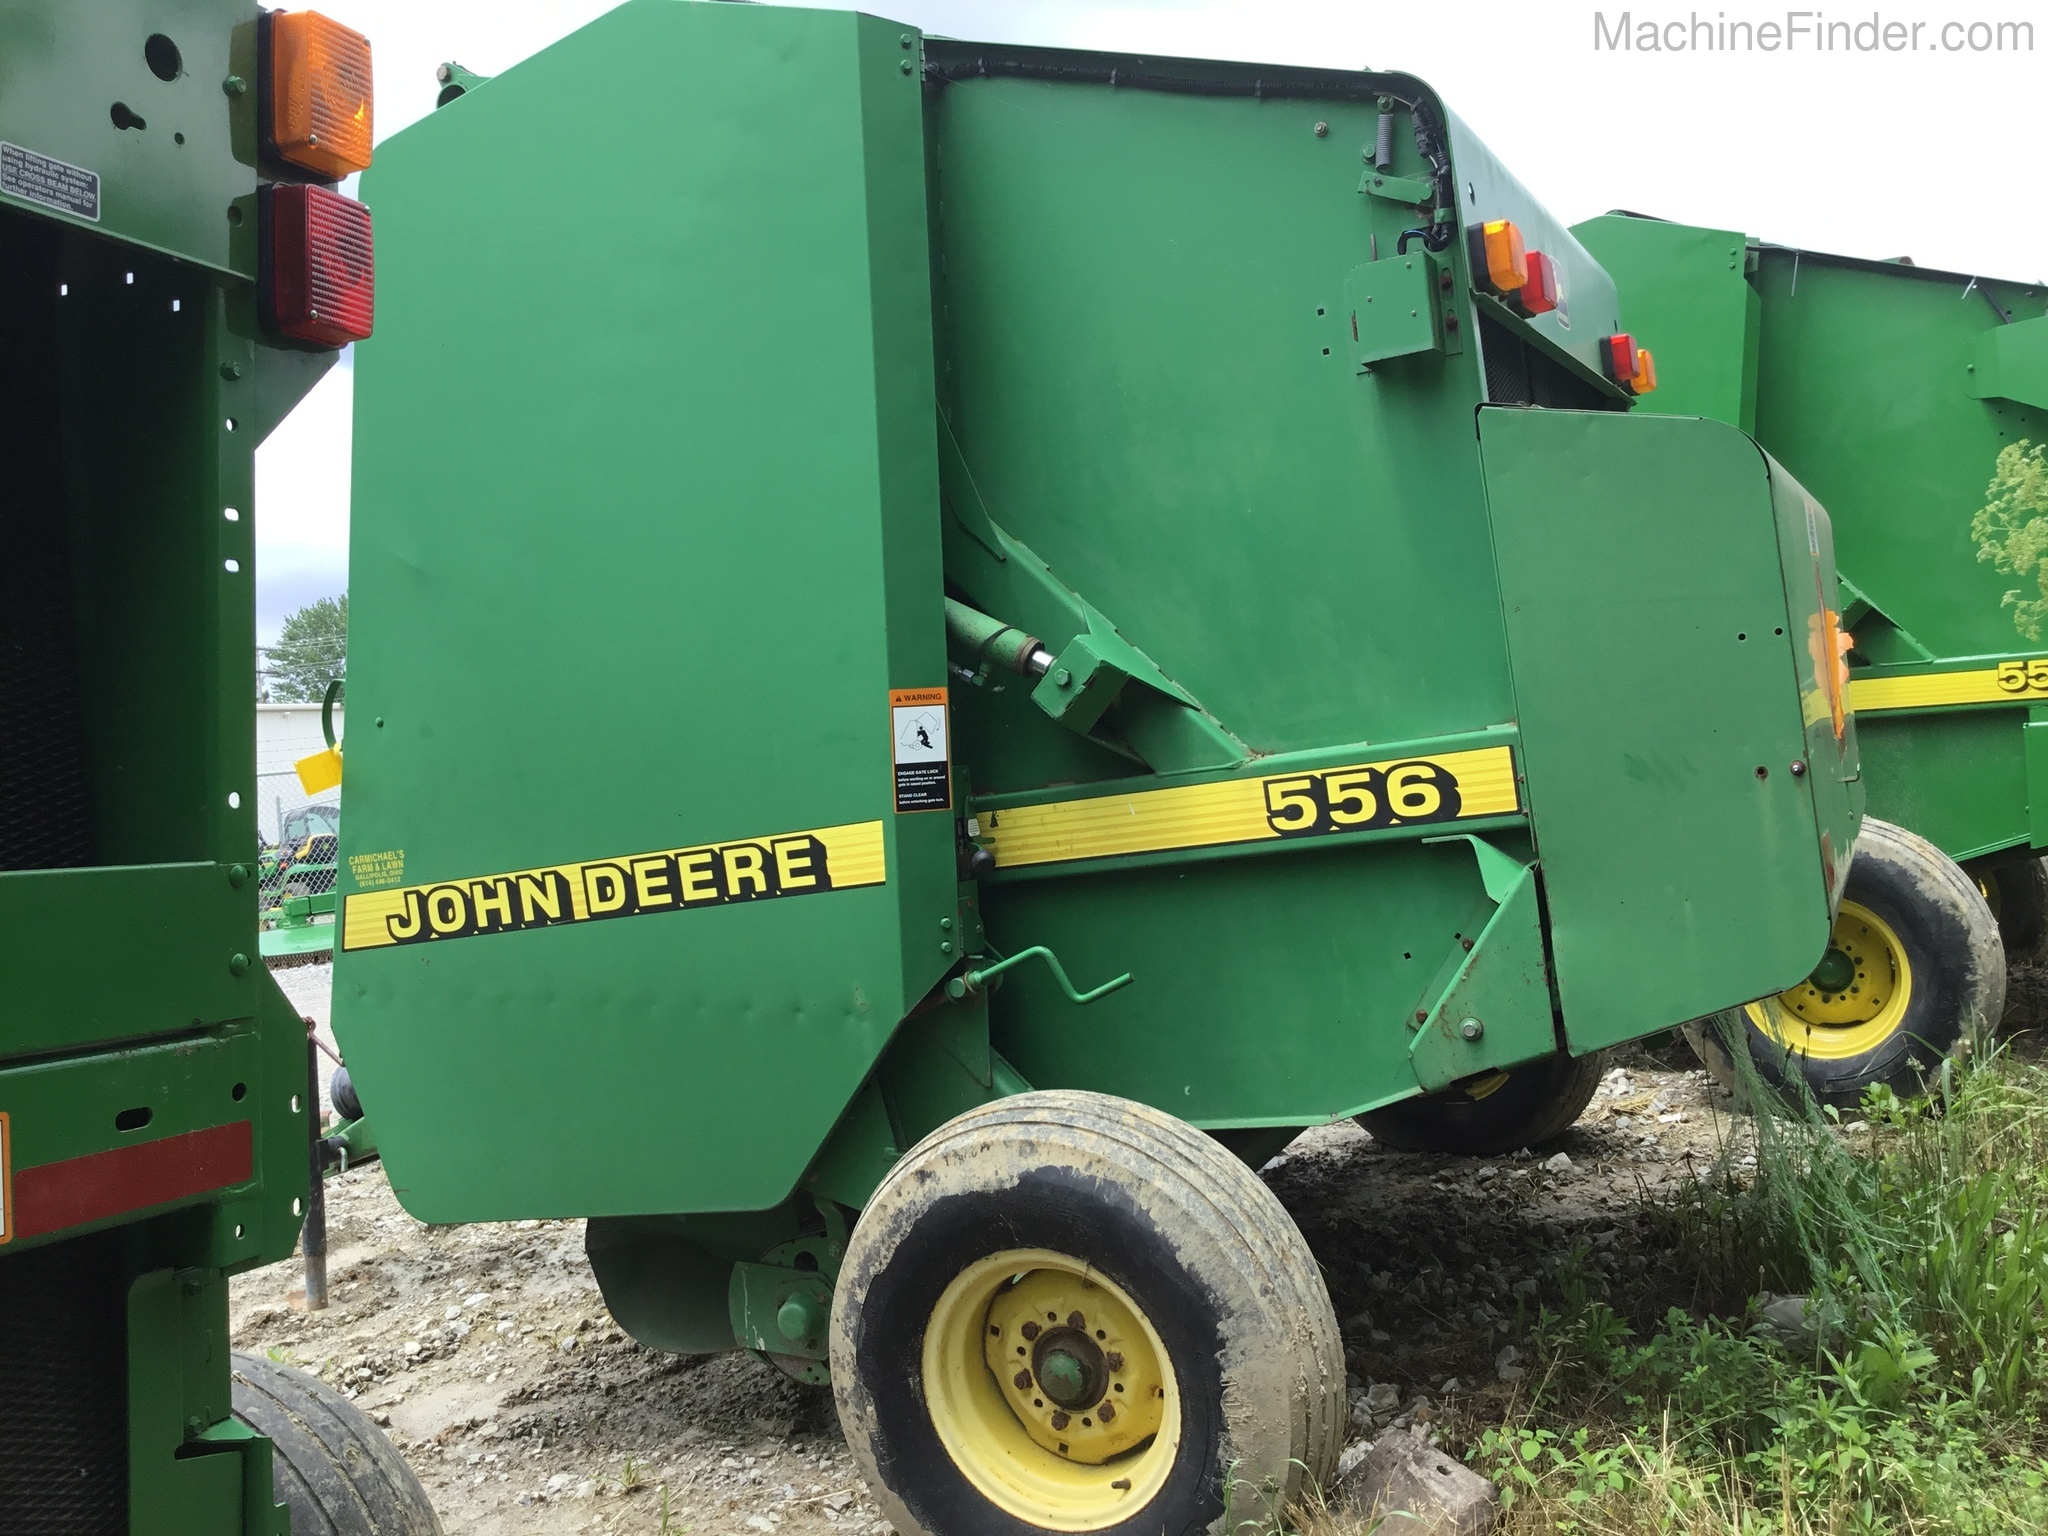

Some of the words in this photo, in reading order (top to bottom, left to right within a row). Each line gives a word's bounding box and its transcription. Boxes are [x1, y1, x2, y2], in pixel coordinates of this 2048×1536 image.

[2, 145, 24, 159] When
[25, 153, 47, 167] lifting
[48, 162, 65, 172] gate
[66, 168, 93, 182] without
[2, 155, 23, 168] using
[25, 160, 59, 179] hydraulic
[61, 174, 88, 189] system:
[2, 163, 18, 174] USE
[19, 169, 46, 184] CROSS
[47, 178, 69, 191] BEAM
[69, 185, 96, 200] BELOW.
[2, 173, 17, 183] See
[18, 180, 54, 196] operators
[55, 190, 82, 205] manual
[83, 199, 93, 209] for
[2, 181, 28, 195] further
[29, 190, 74, 211] information.
[904, 693, 942, 702] WARNING
[1266, 762, 1449, 833] 556
[349, 850, 404, 865] CARMICHAEL'S
[352, 864, 373, 874] FARM
[375, 863, 380, 871] &
[382, 860, 403, 870] LAWN
[355, 871, 388, 880] GALLIPOLIS,
[359, 880, 374, 888] (614)
[387, 871, 561, 939] JOHN
[582, 837, 820, 913] DEERE
